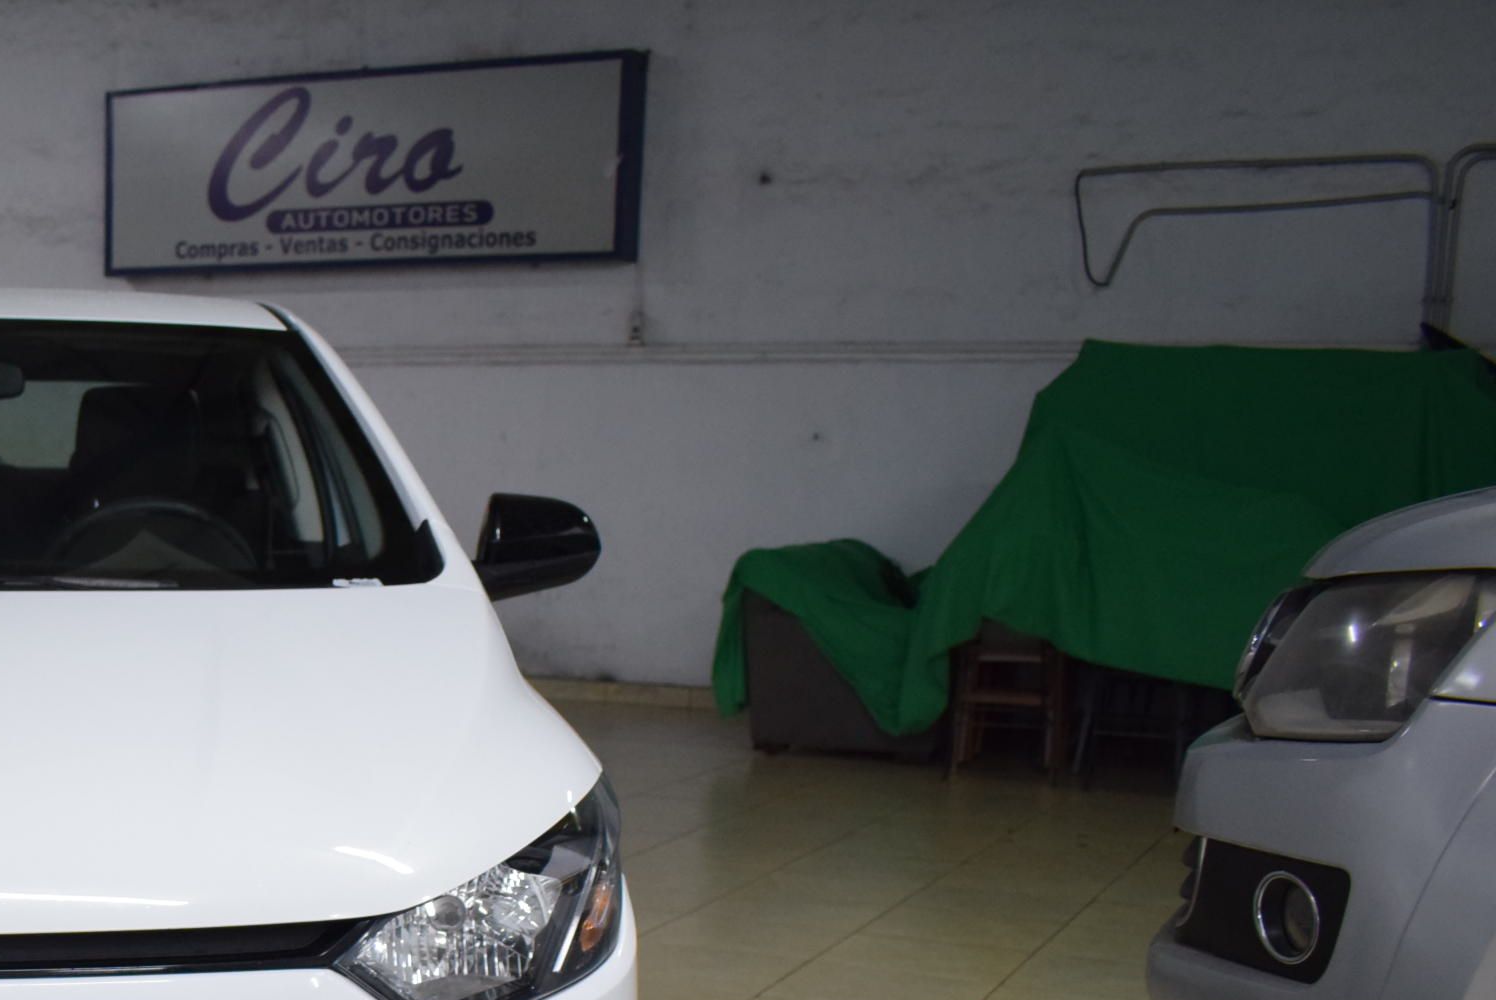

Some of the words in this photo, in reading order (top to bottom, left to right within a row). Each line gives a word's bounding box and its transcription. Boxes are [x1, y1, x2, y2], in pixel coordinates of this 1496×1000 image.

[207, 87, 463, 222] Ciro
[280, 204, 479, 230] AUTOMOTORES
[174, 239, 259, 262] Compras
[279, 235, 349, 255] Ventas
[370, 228, 536, 254] Consignaciones
